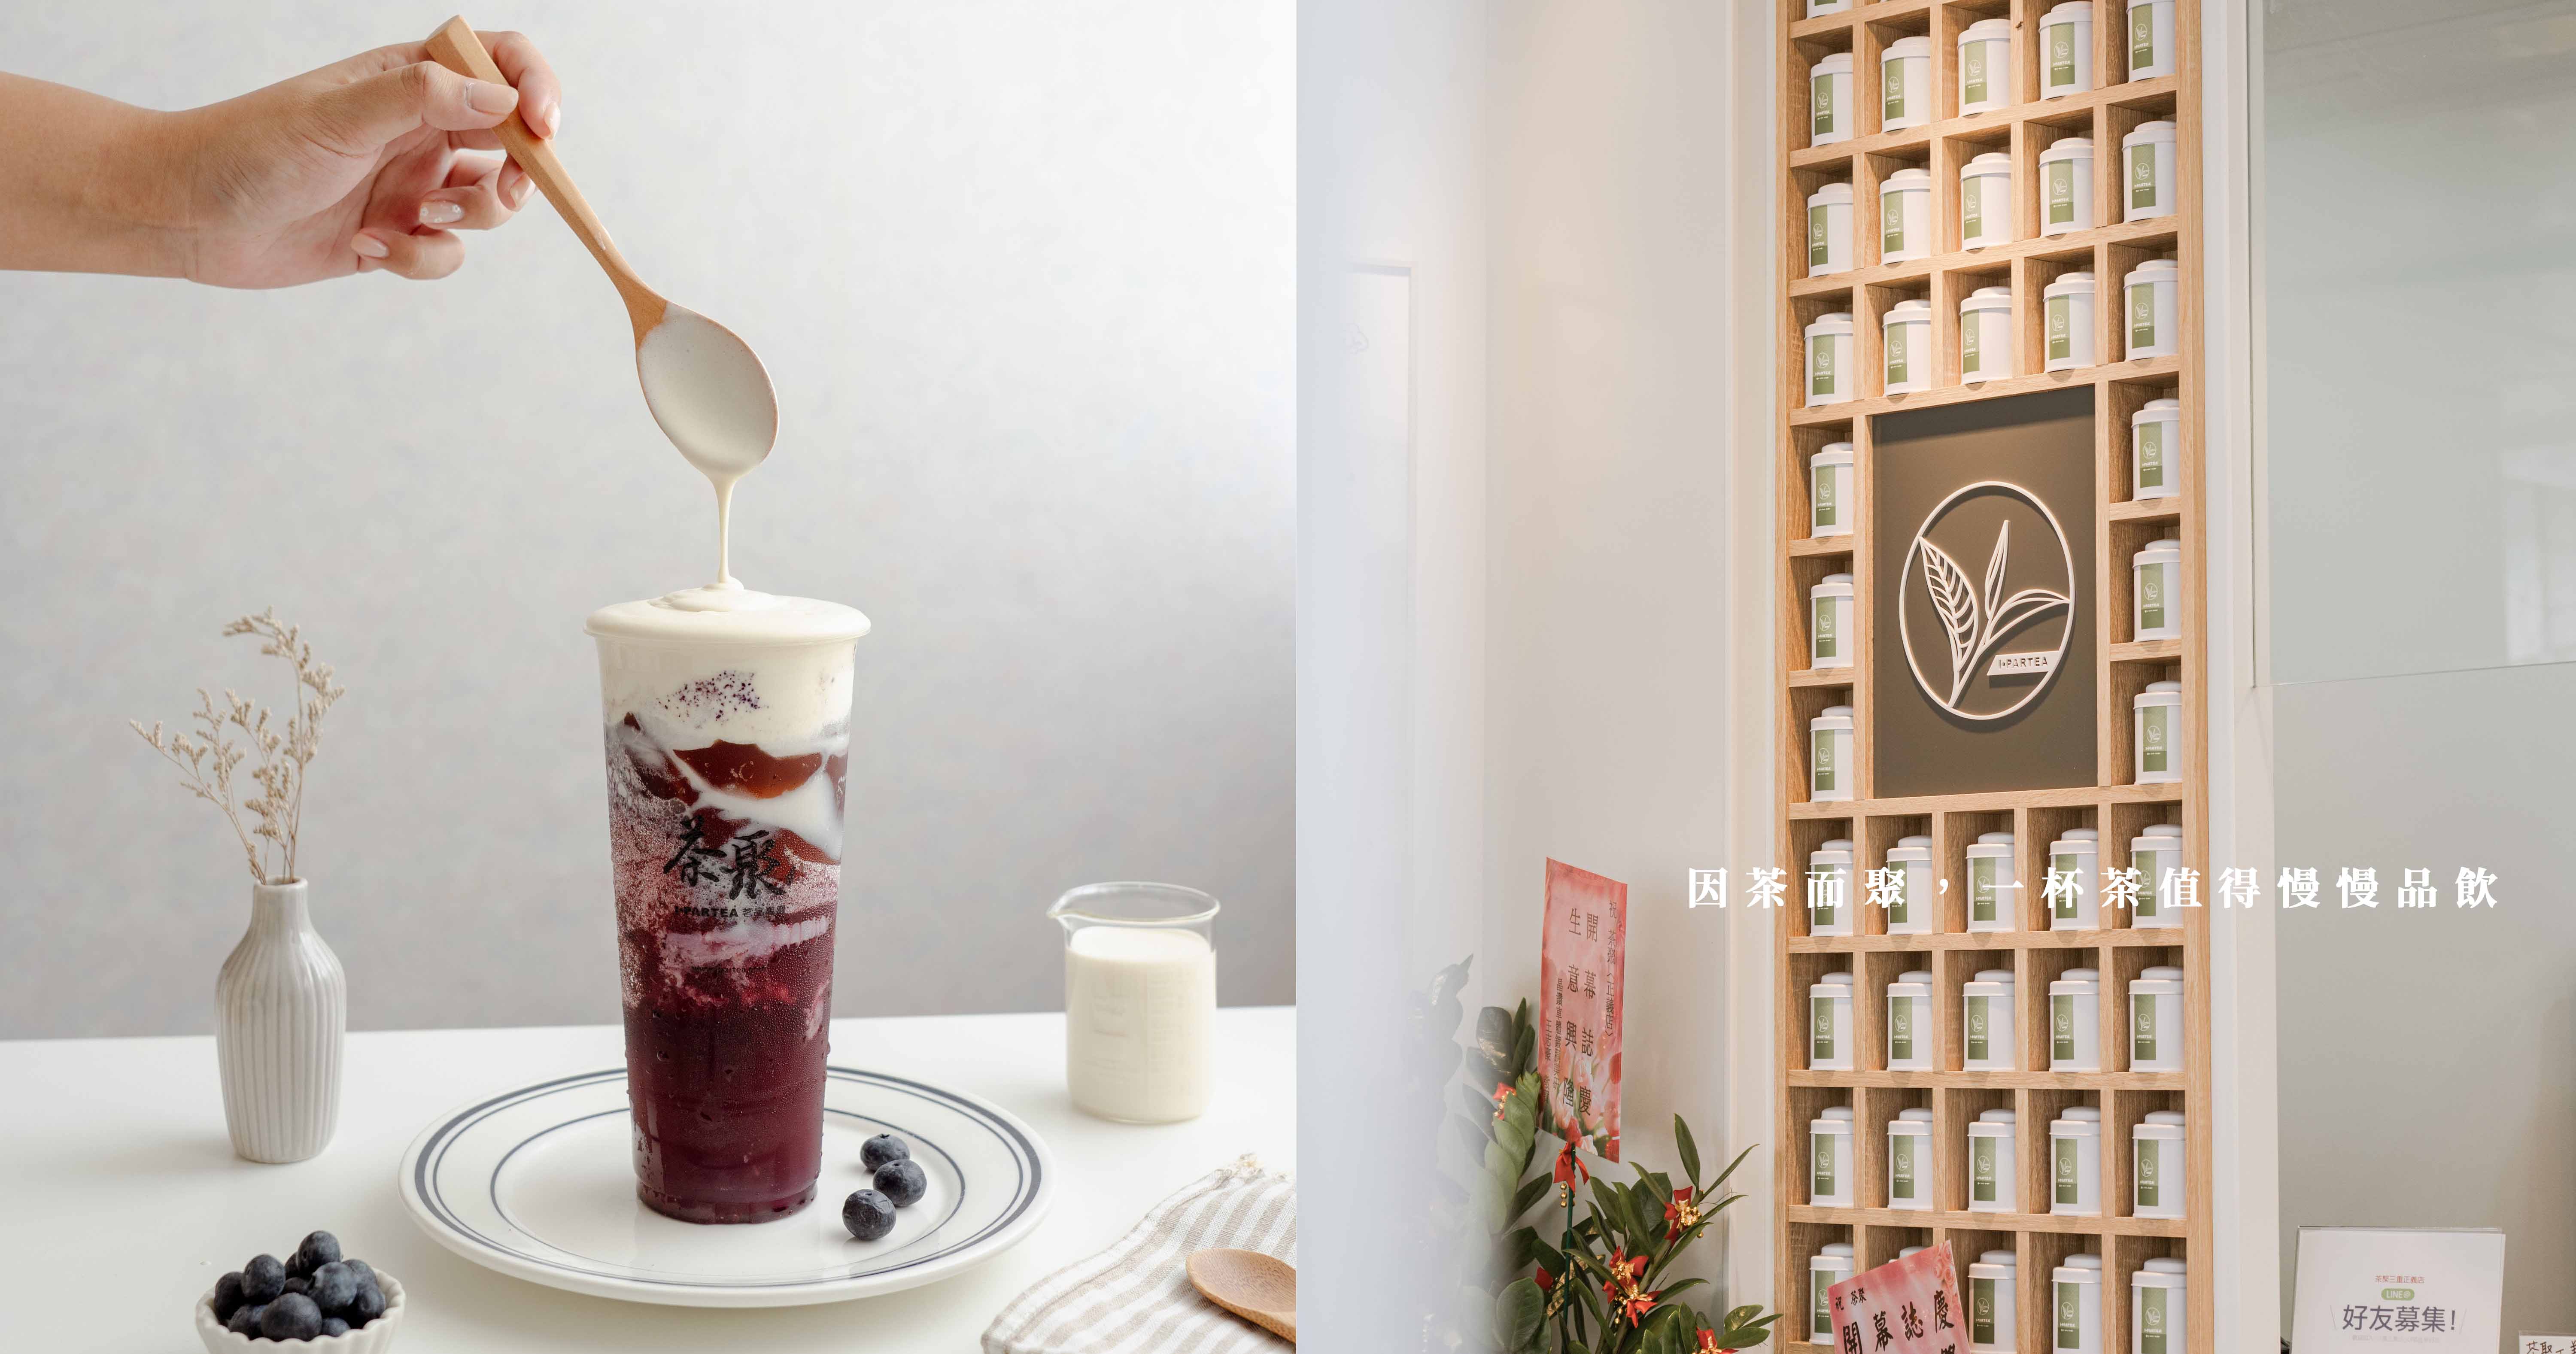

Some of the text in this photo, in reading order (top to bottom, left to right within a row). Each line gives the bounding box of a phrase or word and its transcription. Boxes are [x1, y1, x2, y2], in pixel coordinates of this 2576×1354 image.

[1562, 908, 1582, 1107] 生意興隆
[1578, 912, 1598, 1116] 開幕誌慶
[1835, 1287, 1866, 1311] 祝 茶聚
